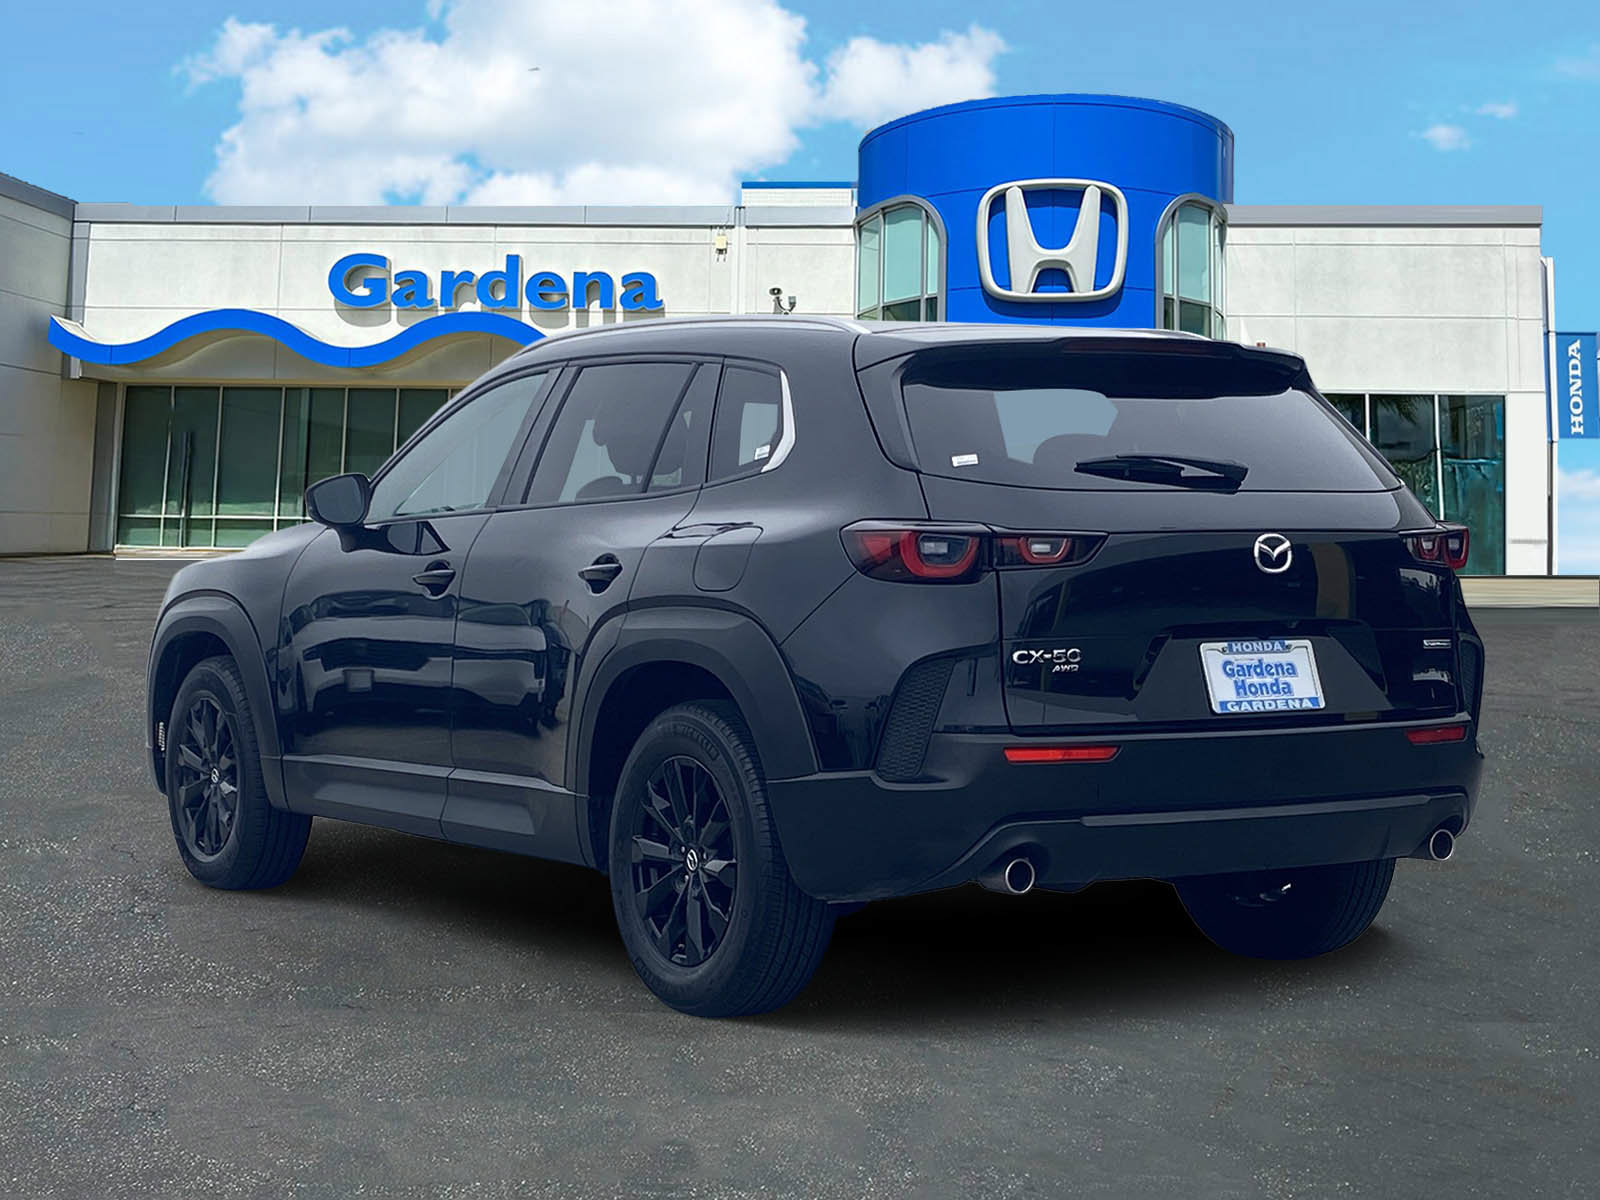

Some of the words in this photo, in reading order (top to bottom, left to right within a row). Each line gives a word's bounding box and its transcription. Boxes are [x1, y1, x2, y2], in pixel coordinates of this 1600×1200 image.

[328, 252, 663, 310] Gardena
[1568, 339, 1584, 435] HONDA
[1012, 648, 1081, 664] CX-50
[1231, 640, 1284, 653] HONDA
[1222, 657, 1297, 678] Gardena
[1234, 678, 1293, 697] Honda
[1226, 698, 1314, 713] GARDENA
